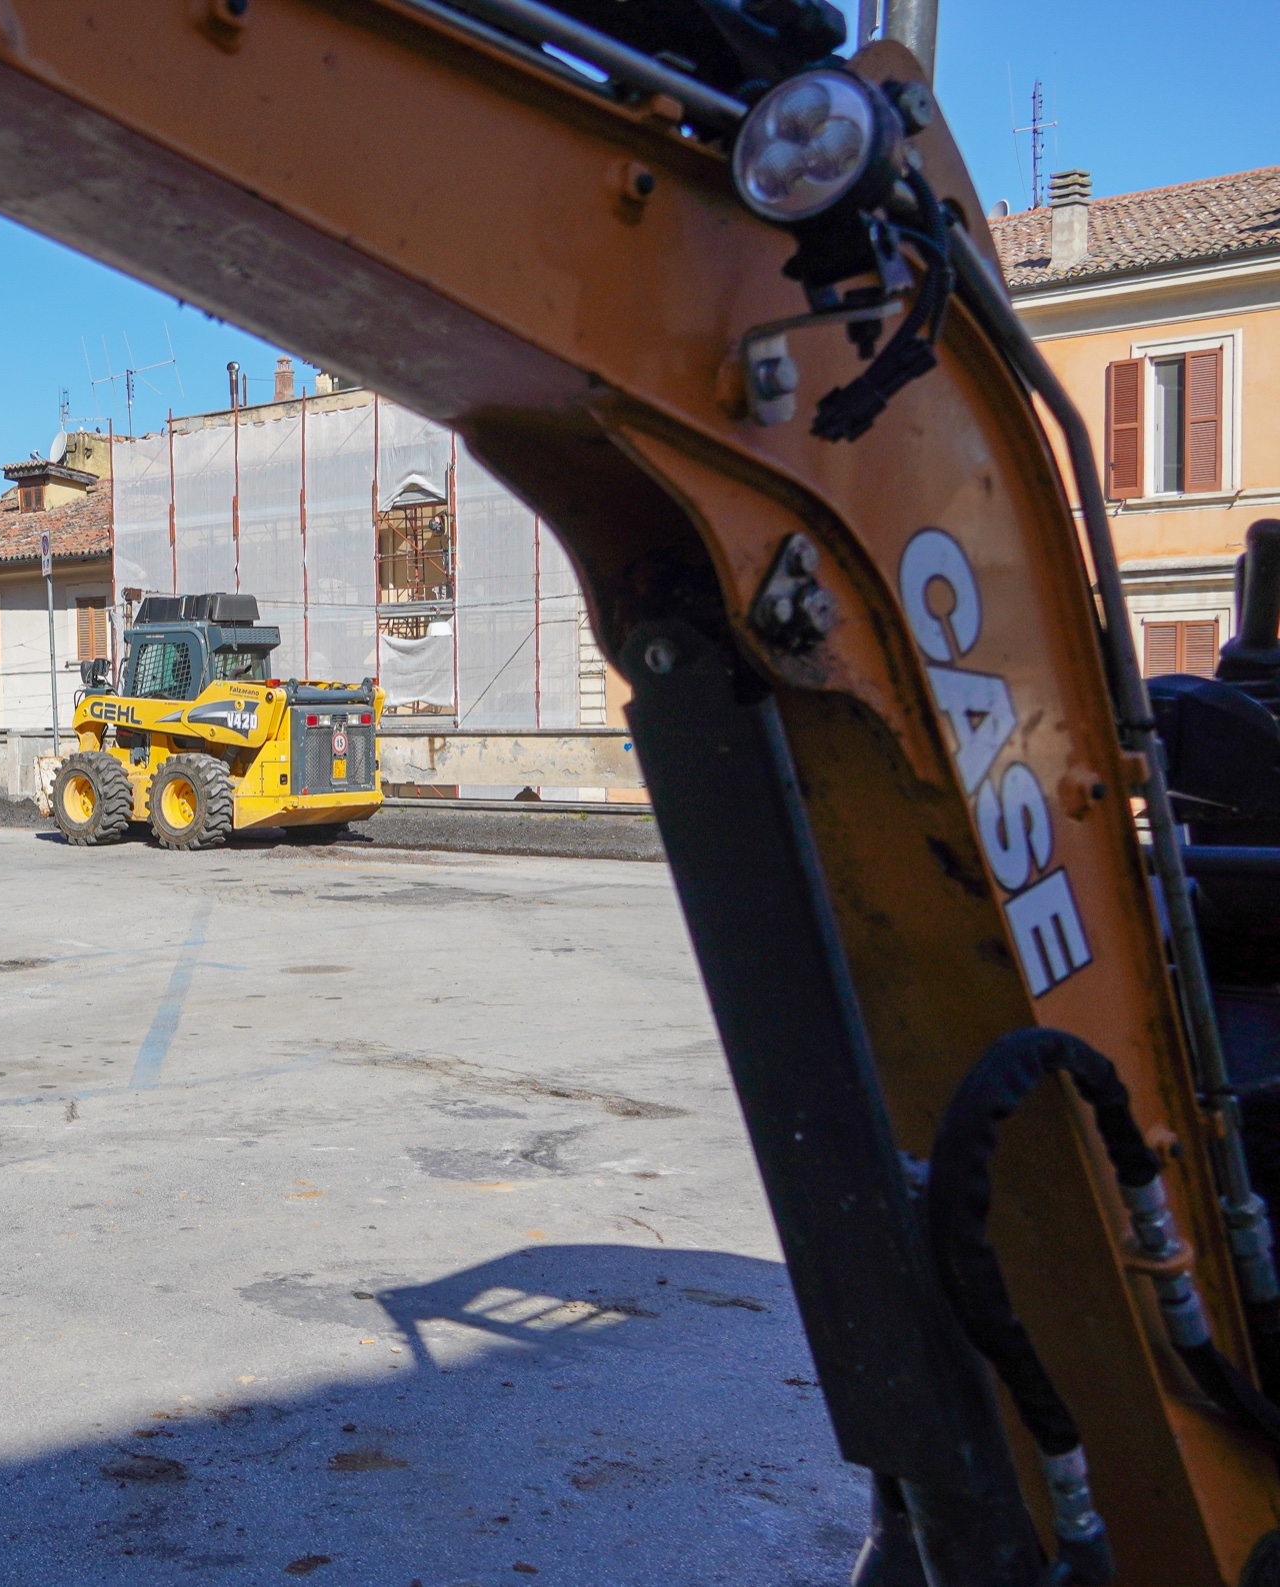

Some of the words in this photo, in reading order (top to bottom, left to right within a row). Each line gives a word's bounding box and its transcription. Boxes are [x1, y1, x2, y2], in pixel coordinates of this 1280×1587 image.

[90, 701, 142, 725] GEHL
[227, 711, 258, 730] V420
[336, 738, 344, 748] 15
[898, 526, 1093, 999] CASE
